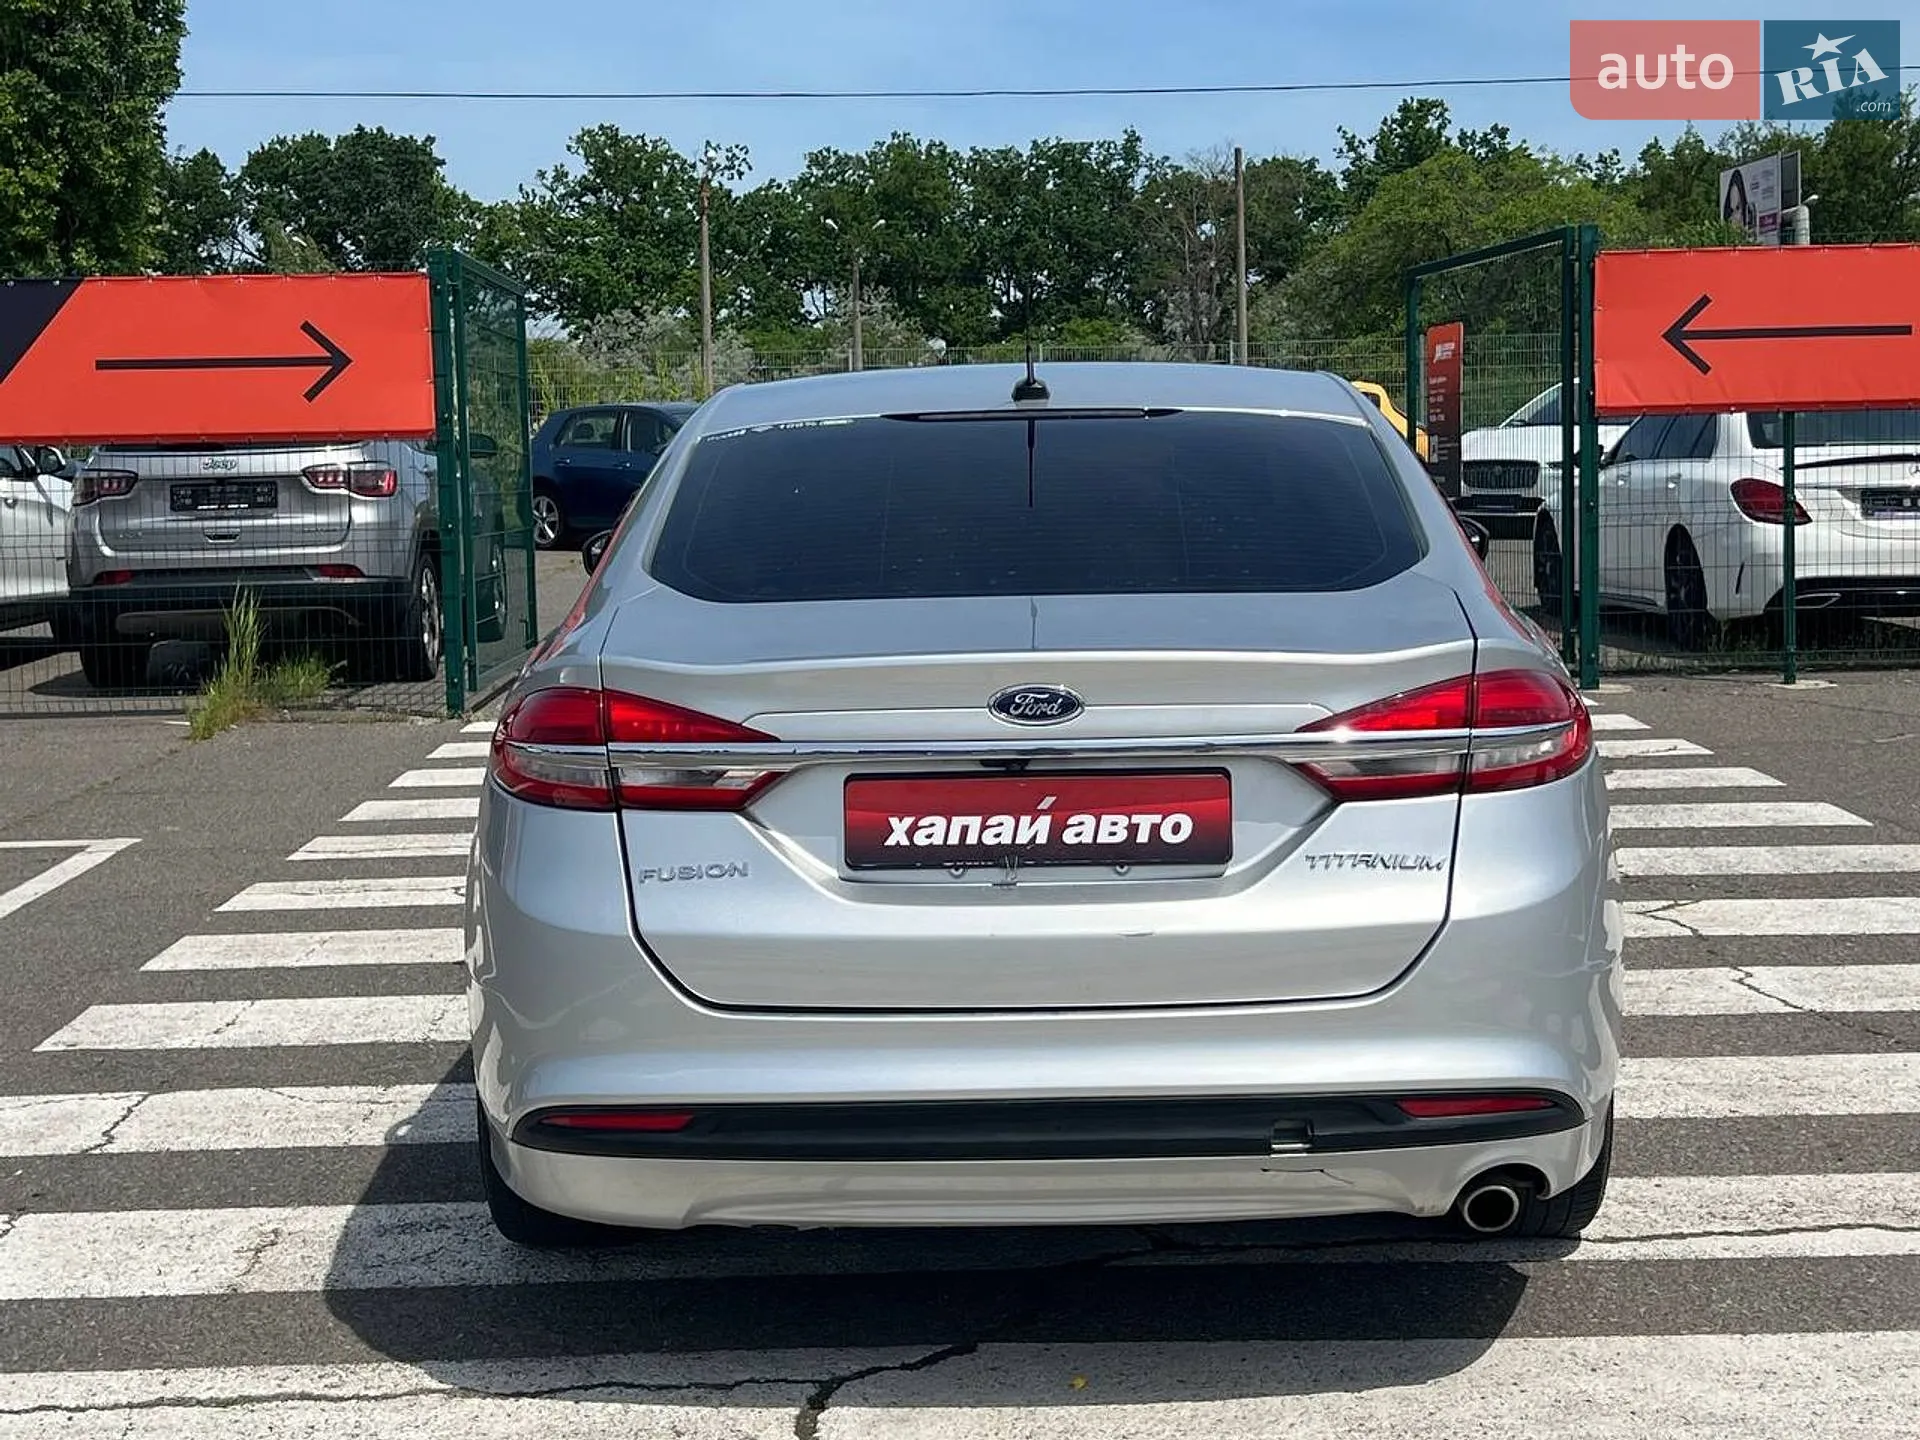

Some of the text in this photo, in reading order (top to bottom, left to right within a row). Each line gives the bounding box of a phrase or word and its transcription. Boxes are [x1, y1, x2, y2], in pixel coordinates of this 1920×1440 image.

[1009, 692, 1064, 716] Ford
[1061, 812, 1194, 845] авто
[639, 861, 749, 883] FUSION
[1304, 852, 1449, 871] TITANIUM
